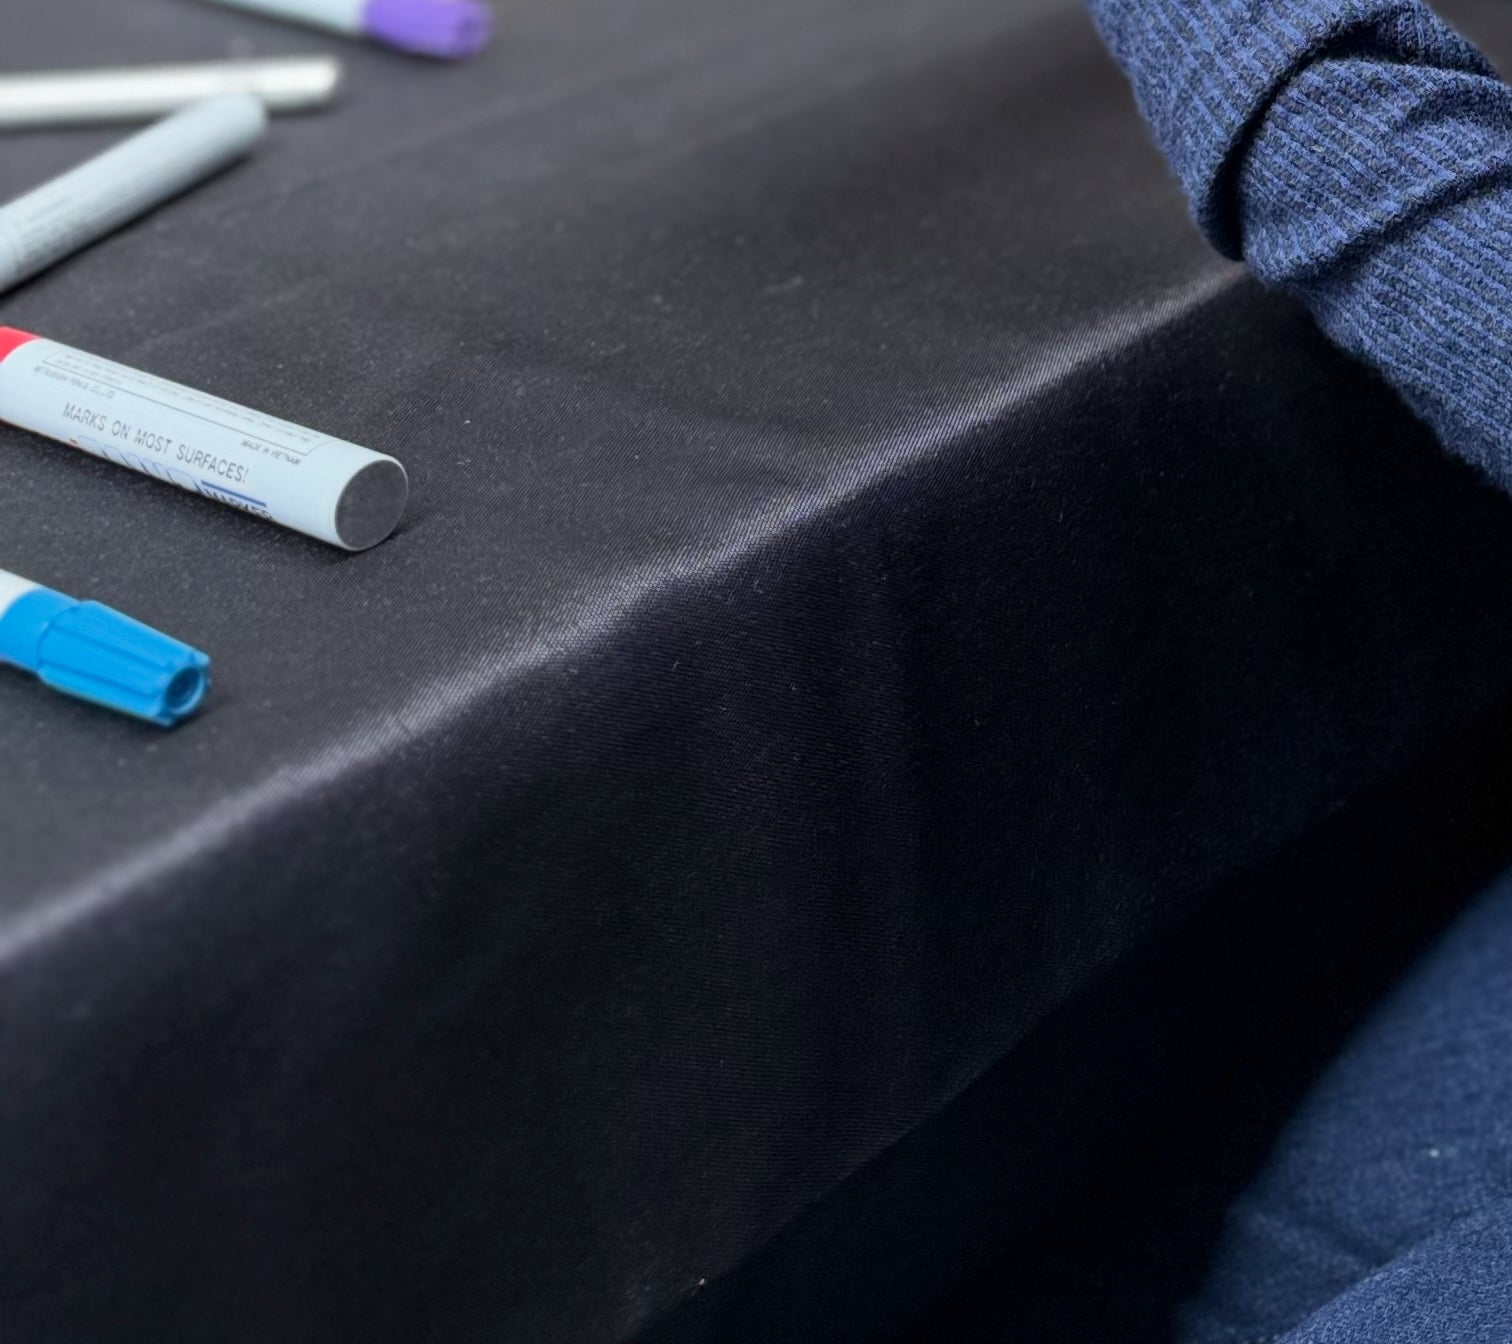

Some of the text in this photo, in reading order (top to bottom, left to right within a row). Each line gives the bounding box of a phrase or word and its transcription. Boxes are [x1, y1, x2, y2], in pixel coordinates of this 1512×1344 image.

[62, 402, 108, 434] MARKS
[111, 420, 131, 441] ON
[133, 428, 174, 456] MOST
[176, 443, 250, 485] SURFACES!
